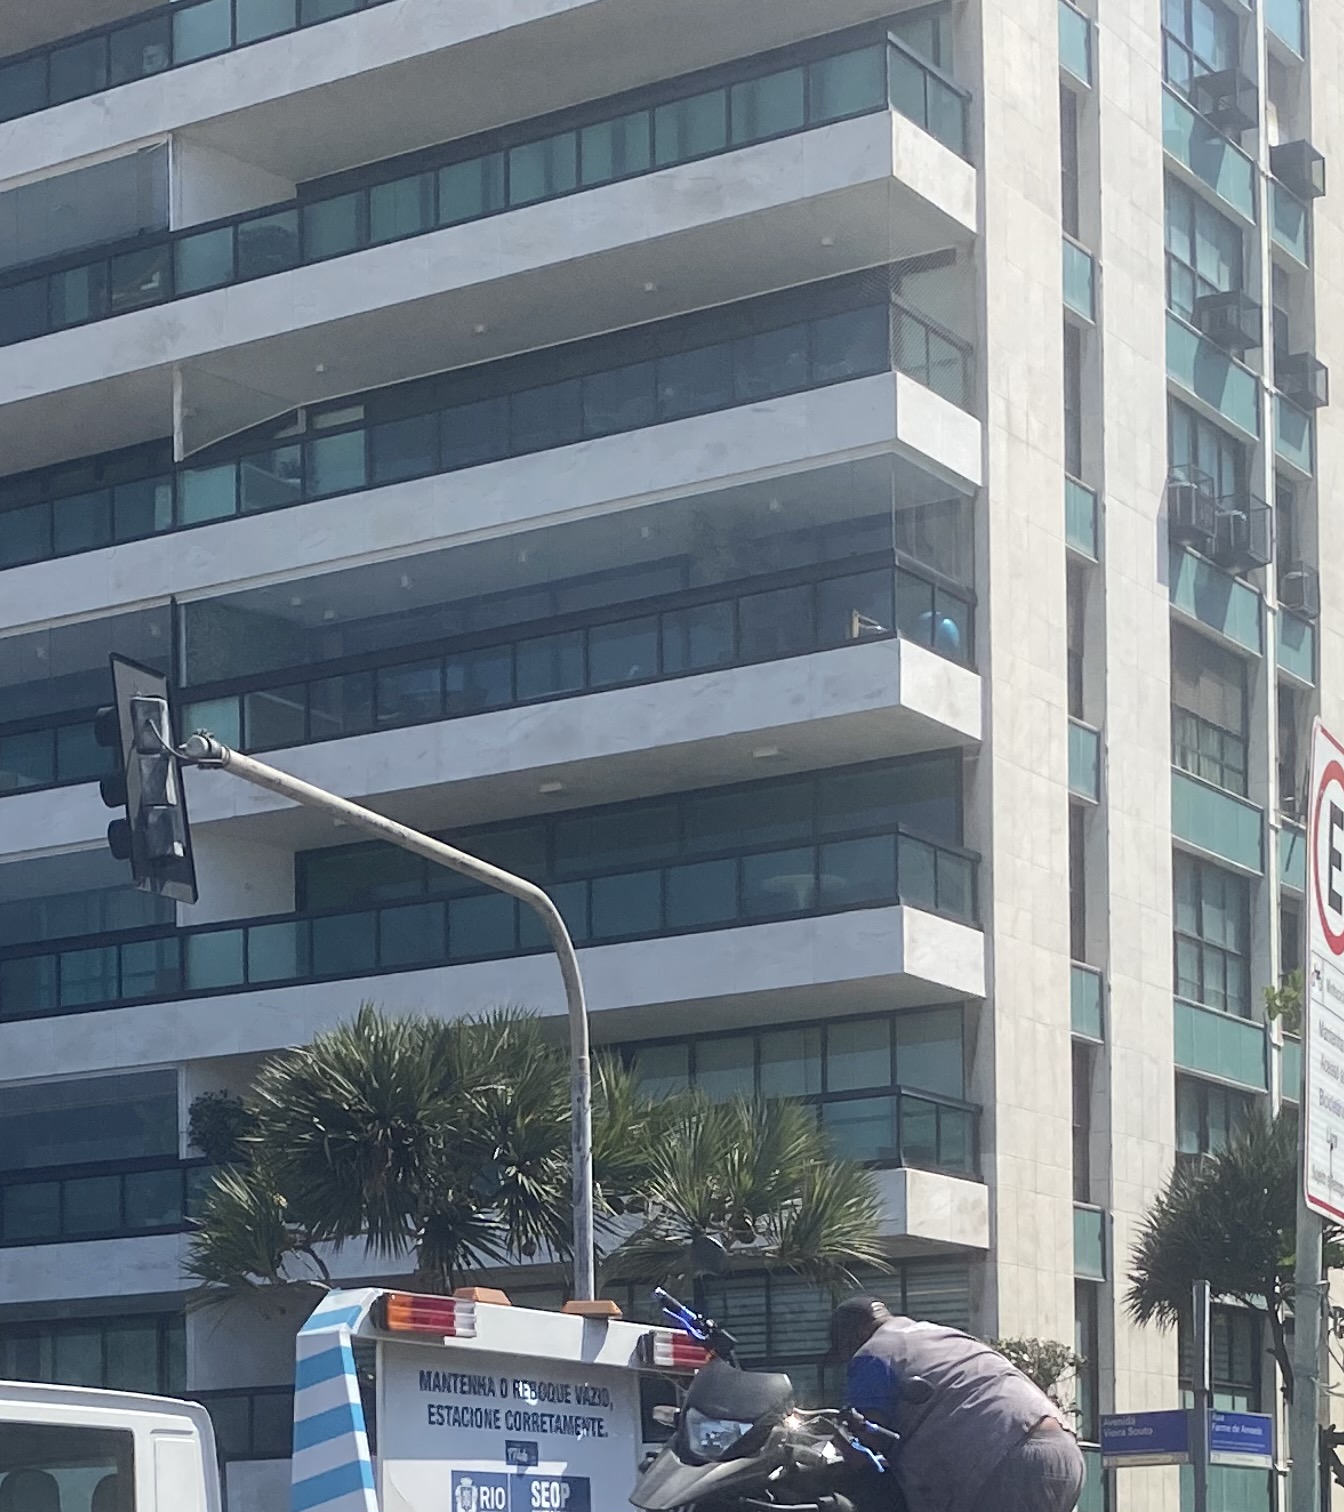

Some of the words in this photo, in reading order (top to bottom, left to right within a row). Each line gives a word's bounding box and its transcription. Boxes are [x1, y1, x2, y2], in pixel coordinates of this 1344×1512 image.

[1328, 801, 1344, 916] E
[419, 1370, 496, 1398] MANTENHA
[500, 1378, 509, 1399] O
[513, 1380, 571, 1404] REBOQUE
[428, 1404, 501, 1430] ESTACIONE
[506, 1410, 609, 1438] CORRETAMENTE.
[1103, 1416, 1136, 1426] Avenida
[1128, 1427, 1153, 1436] Souto
[479, 1486, 506, 1510] RIO
[531, 1480, 571, 1509] SEOP
